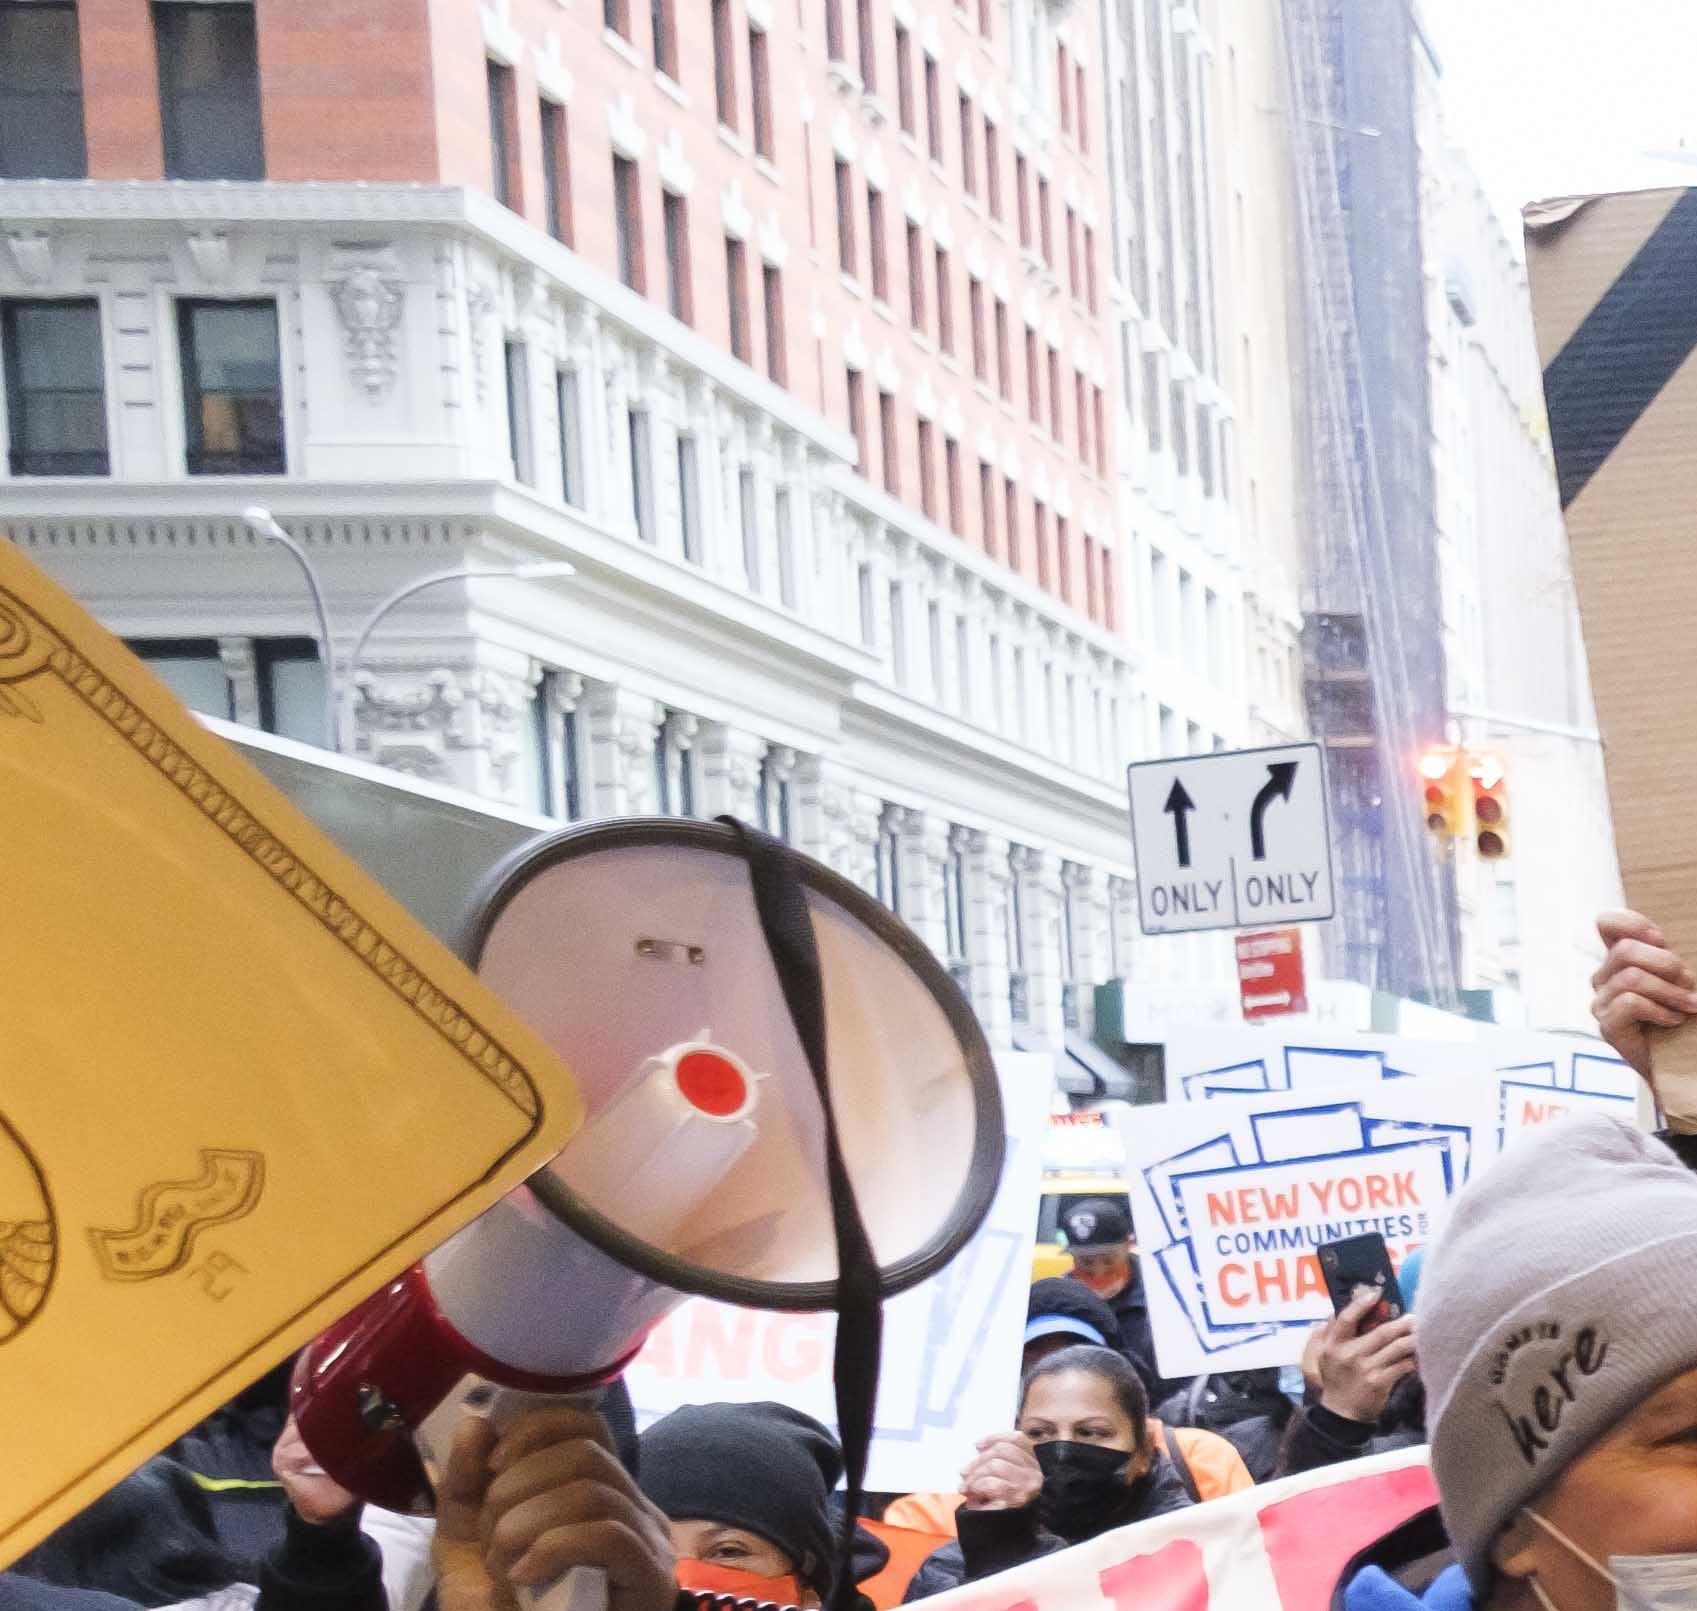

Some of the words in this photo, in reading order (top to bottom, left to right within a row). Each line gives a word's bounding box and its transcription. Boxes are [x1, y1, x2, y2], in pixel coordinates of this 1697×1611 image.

[1151, 880, 1224, 917] ONLY
[1246, 870, 1320, 908] ONLY
[1206, 1182, 1299, 1228] NEW
[1309, 1170, 1422, 1214] YORK
[1216, 1214, 1413, 1257] COMMUNITIES
[1492, 1326, 1609, 1465] here
